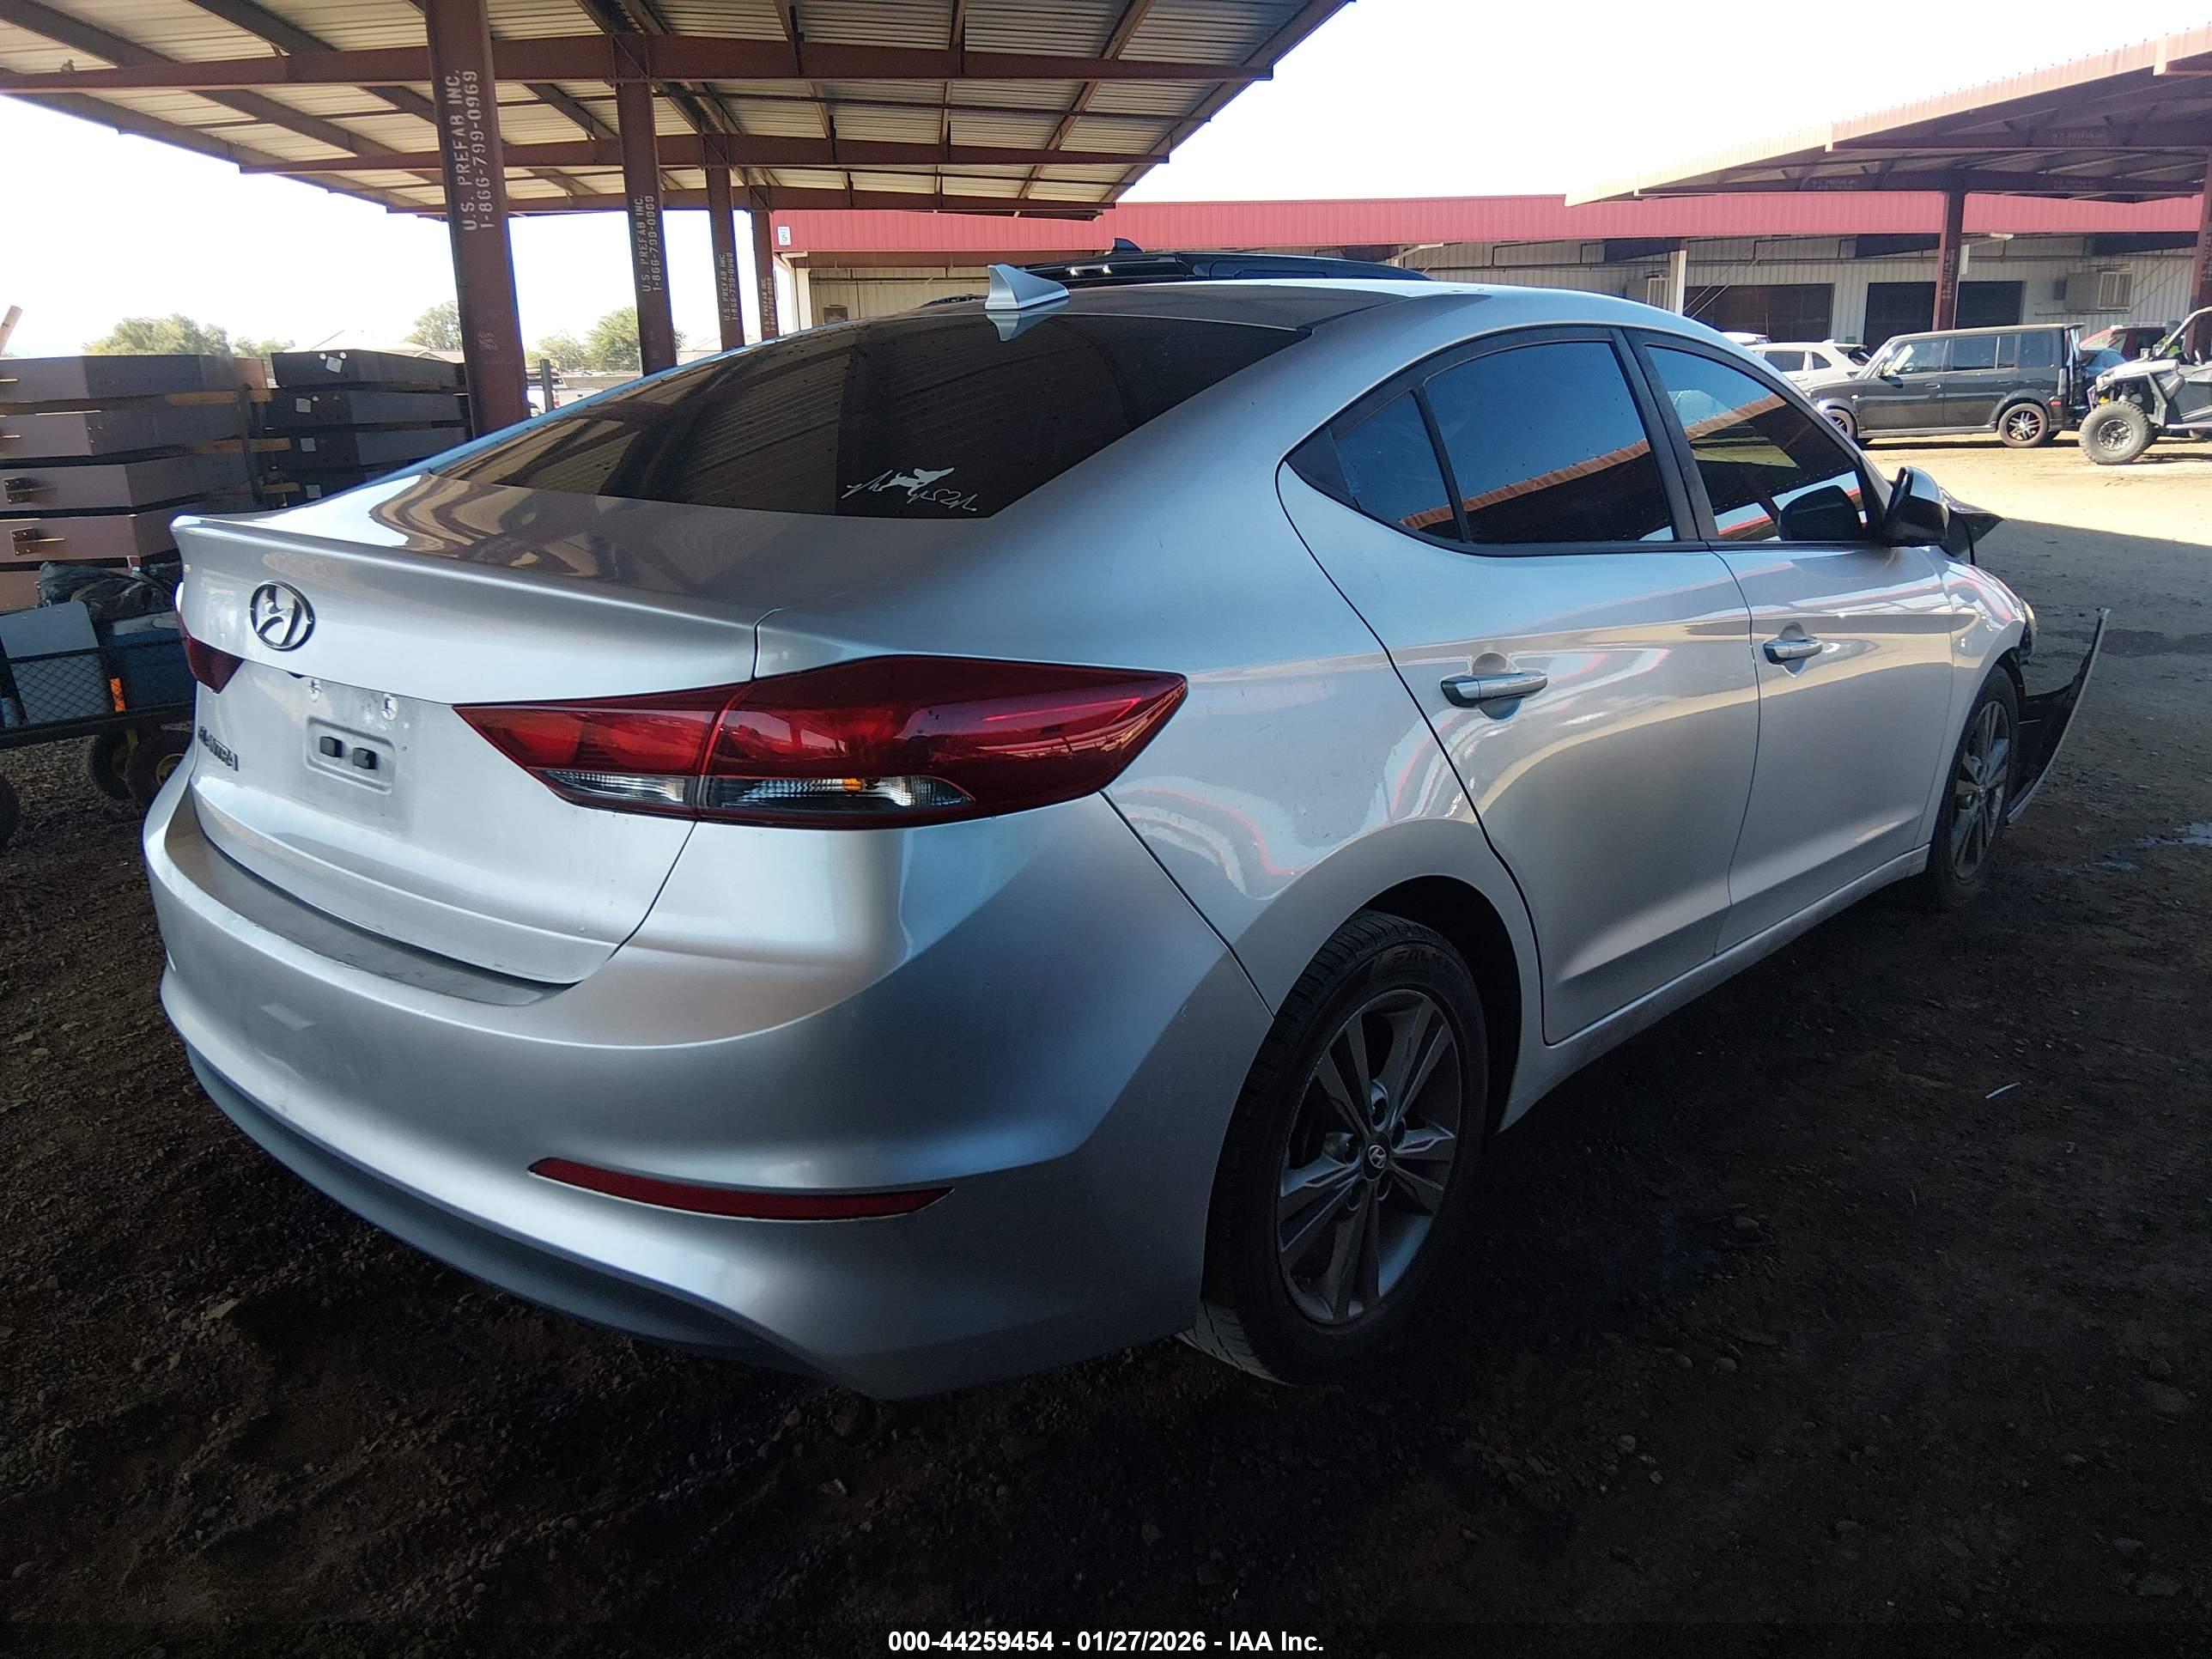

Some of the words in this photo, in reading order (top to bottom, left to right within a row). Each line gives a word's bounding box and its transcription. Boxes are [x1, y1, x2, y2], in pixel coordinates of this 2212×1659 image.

[445, 70, 463, 105] INC.
[450, 114, 472, 185] PREFAB
[462, 70, 495, 228] 1-866-799-0969
[461, 197, 477, 231] U.S.
[636, 222, 649, 265] PREFAB
[644, 195, 663, 291] 1-866-799-0969
